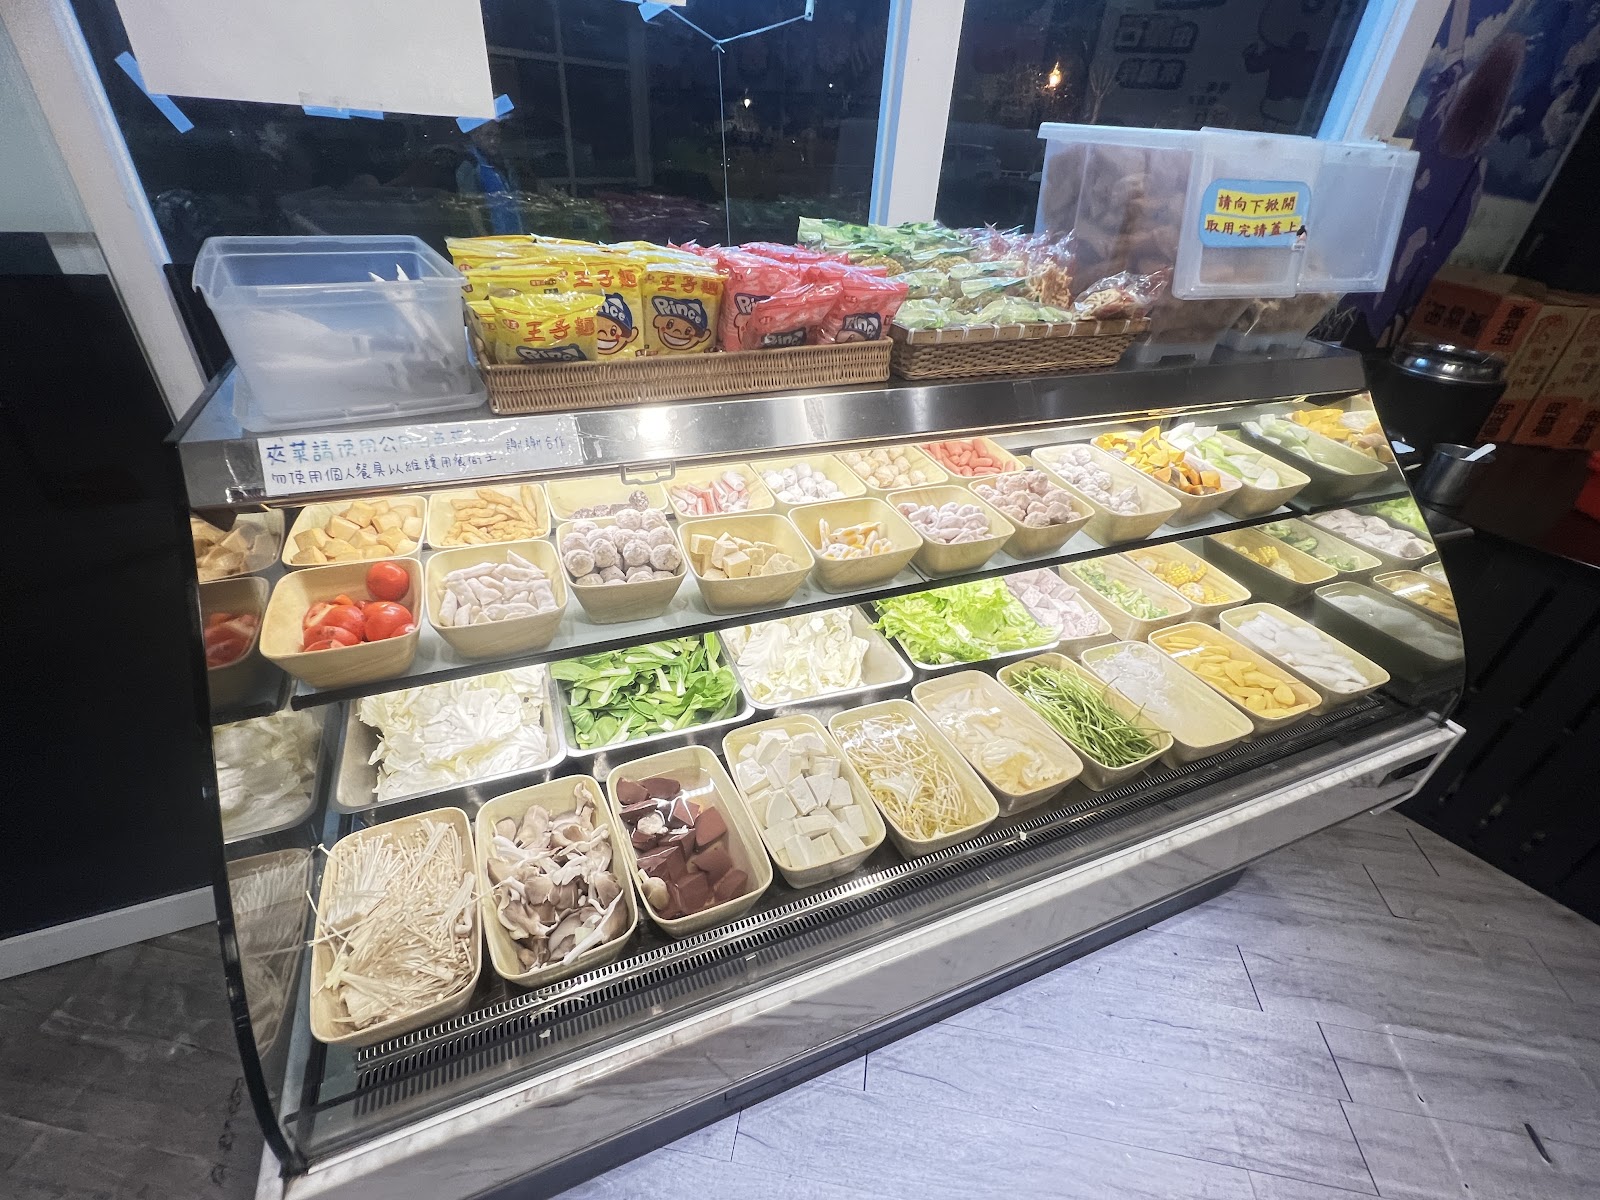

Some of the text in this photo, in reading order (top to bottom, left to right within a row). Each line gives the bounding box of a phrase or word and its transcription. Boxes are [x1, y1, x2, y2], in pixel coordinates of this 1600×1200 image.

[1218, 195, 1296, 214] 請向下掀開
[1205, 220, 1298, 237] 取用完請蓋上
[600, 302, 626, 321] nce
[653, 298, 702, 324] Prince
[736, 296, 757, 314] Pri
[520, 348, 576, 361] Princ
